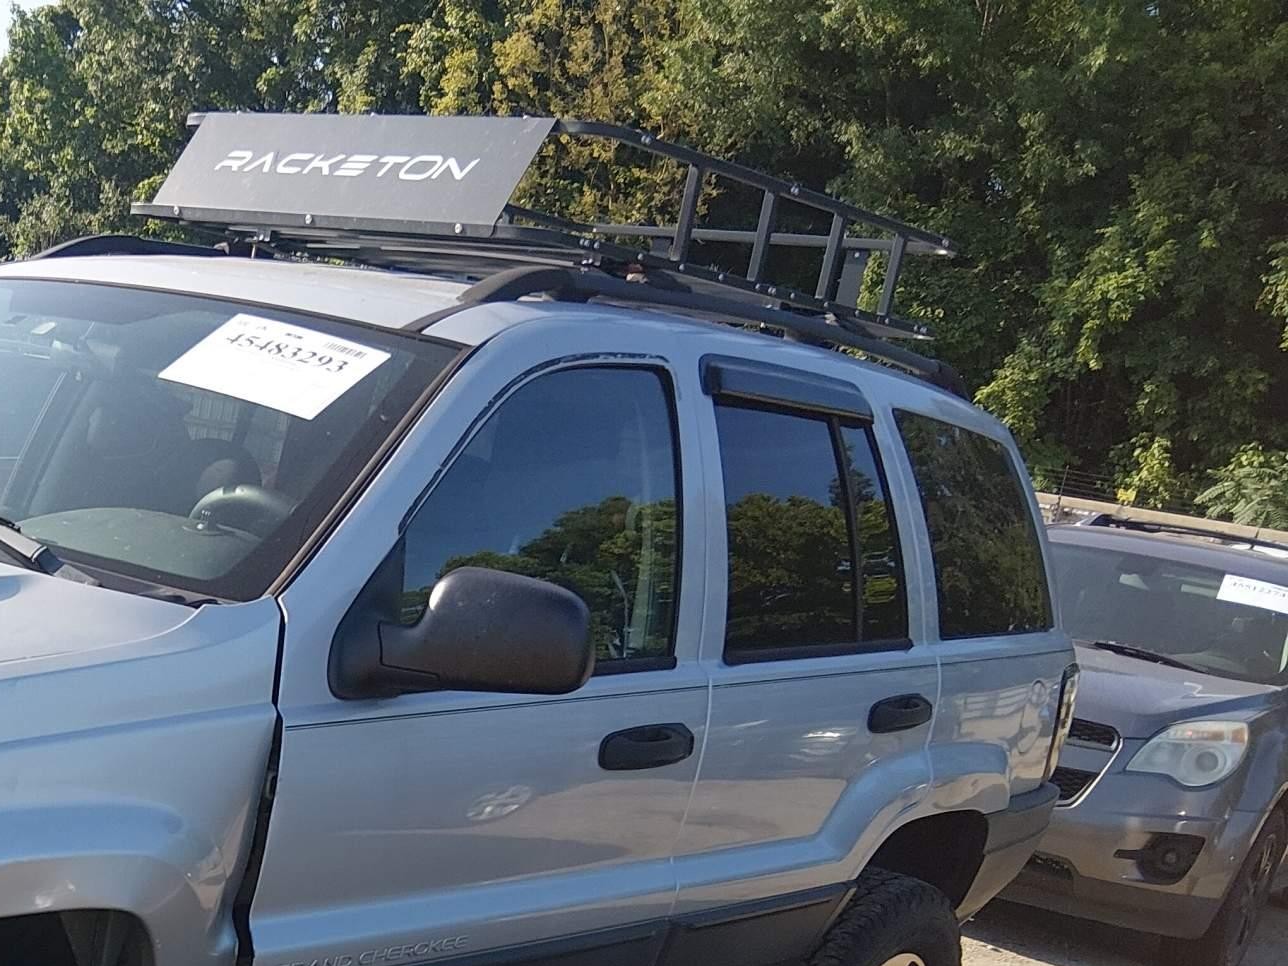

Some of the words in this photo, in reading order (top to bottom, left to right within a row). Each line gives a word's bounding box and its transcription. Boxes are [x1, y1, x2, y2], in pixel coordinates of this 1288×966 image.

[214, 150, 481, 181] RACKETON
[226, 333, 349, 373] 45483293
[358, 935, 470, 966] CHEROKEE
